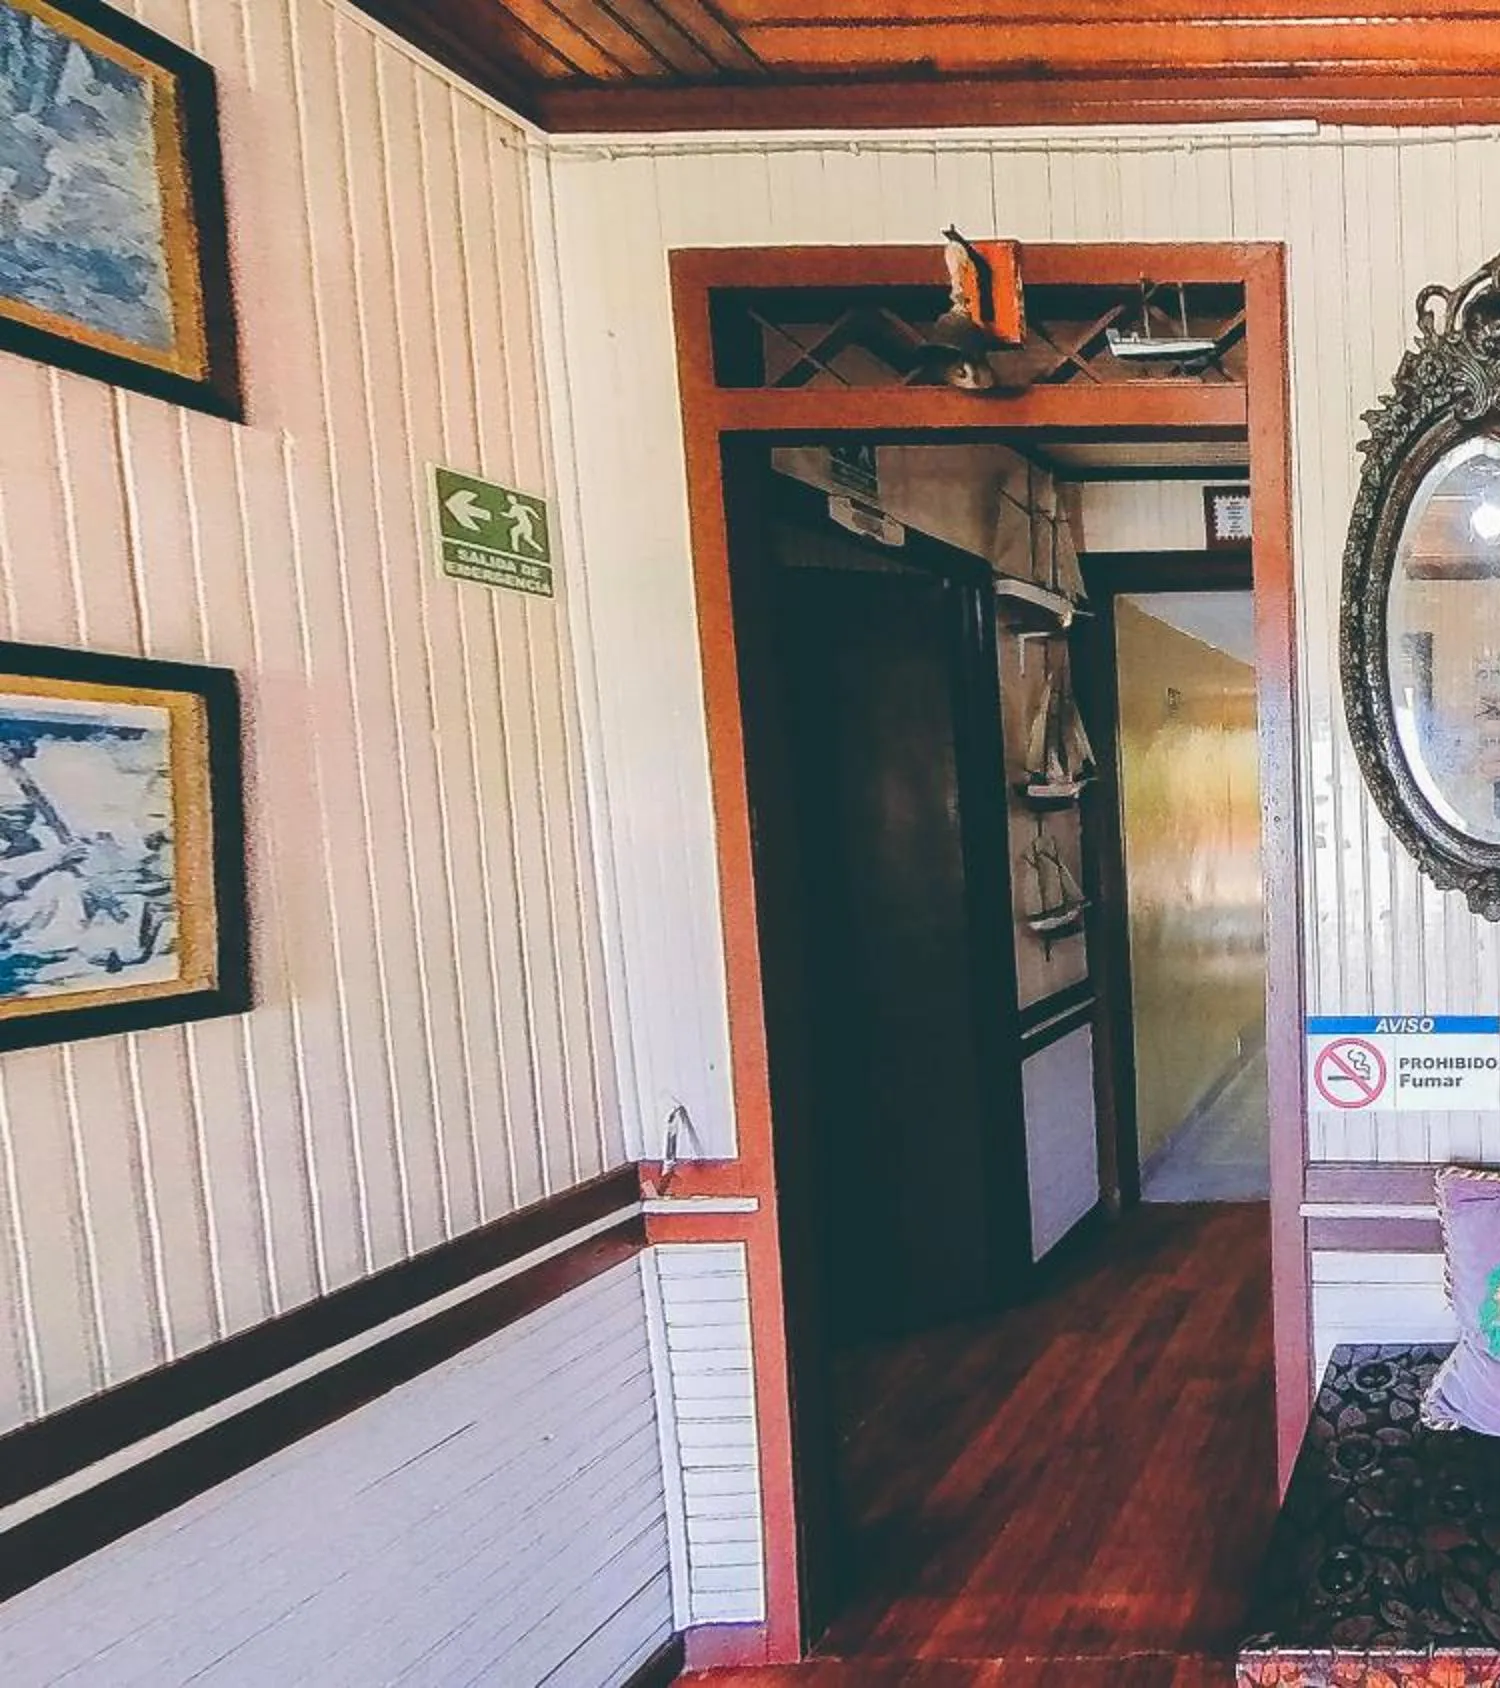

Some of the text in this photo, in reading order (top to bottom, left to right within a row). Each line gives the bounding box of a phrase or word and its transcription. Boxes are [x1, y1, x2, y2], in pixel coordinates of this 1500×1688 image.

[457, 549, 542, 580] SALIDA DE
[1375, 1018, 1434, 1033] AVISO
[1399, 1057, 1498, 1070] PROHIBIDO
[1399, 1074, 1463, 1088] Fumar
